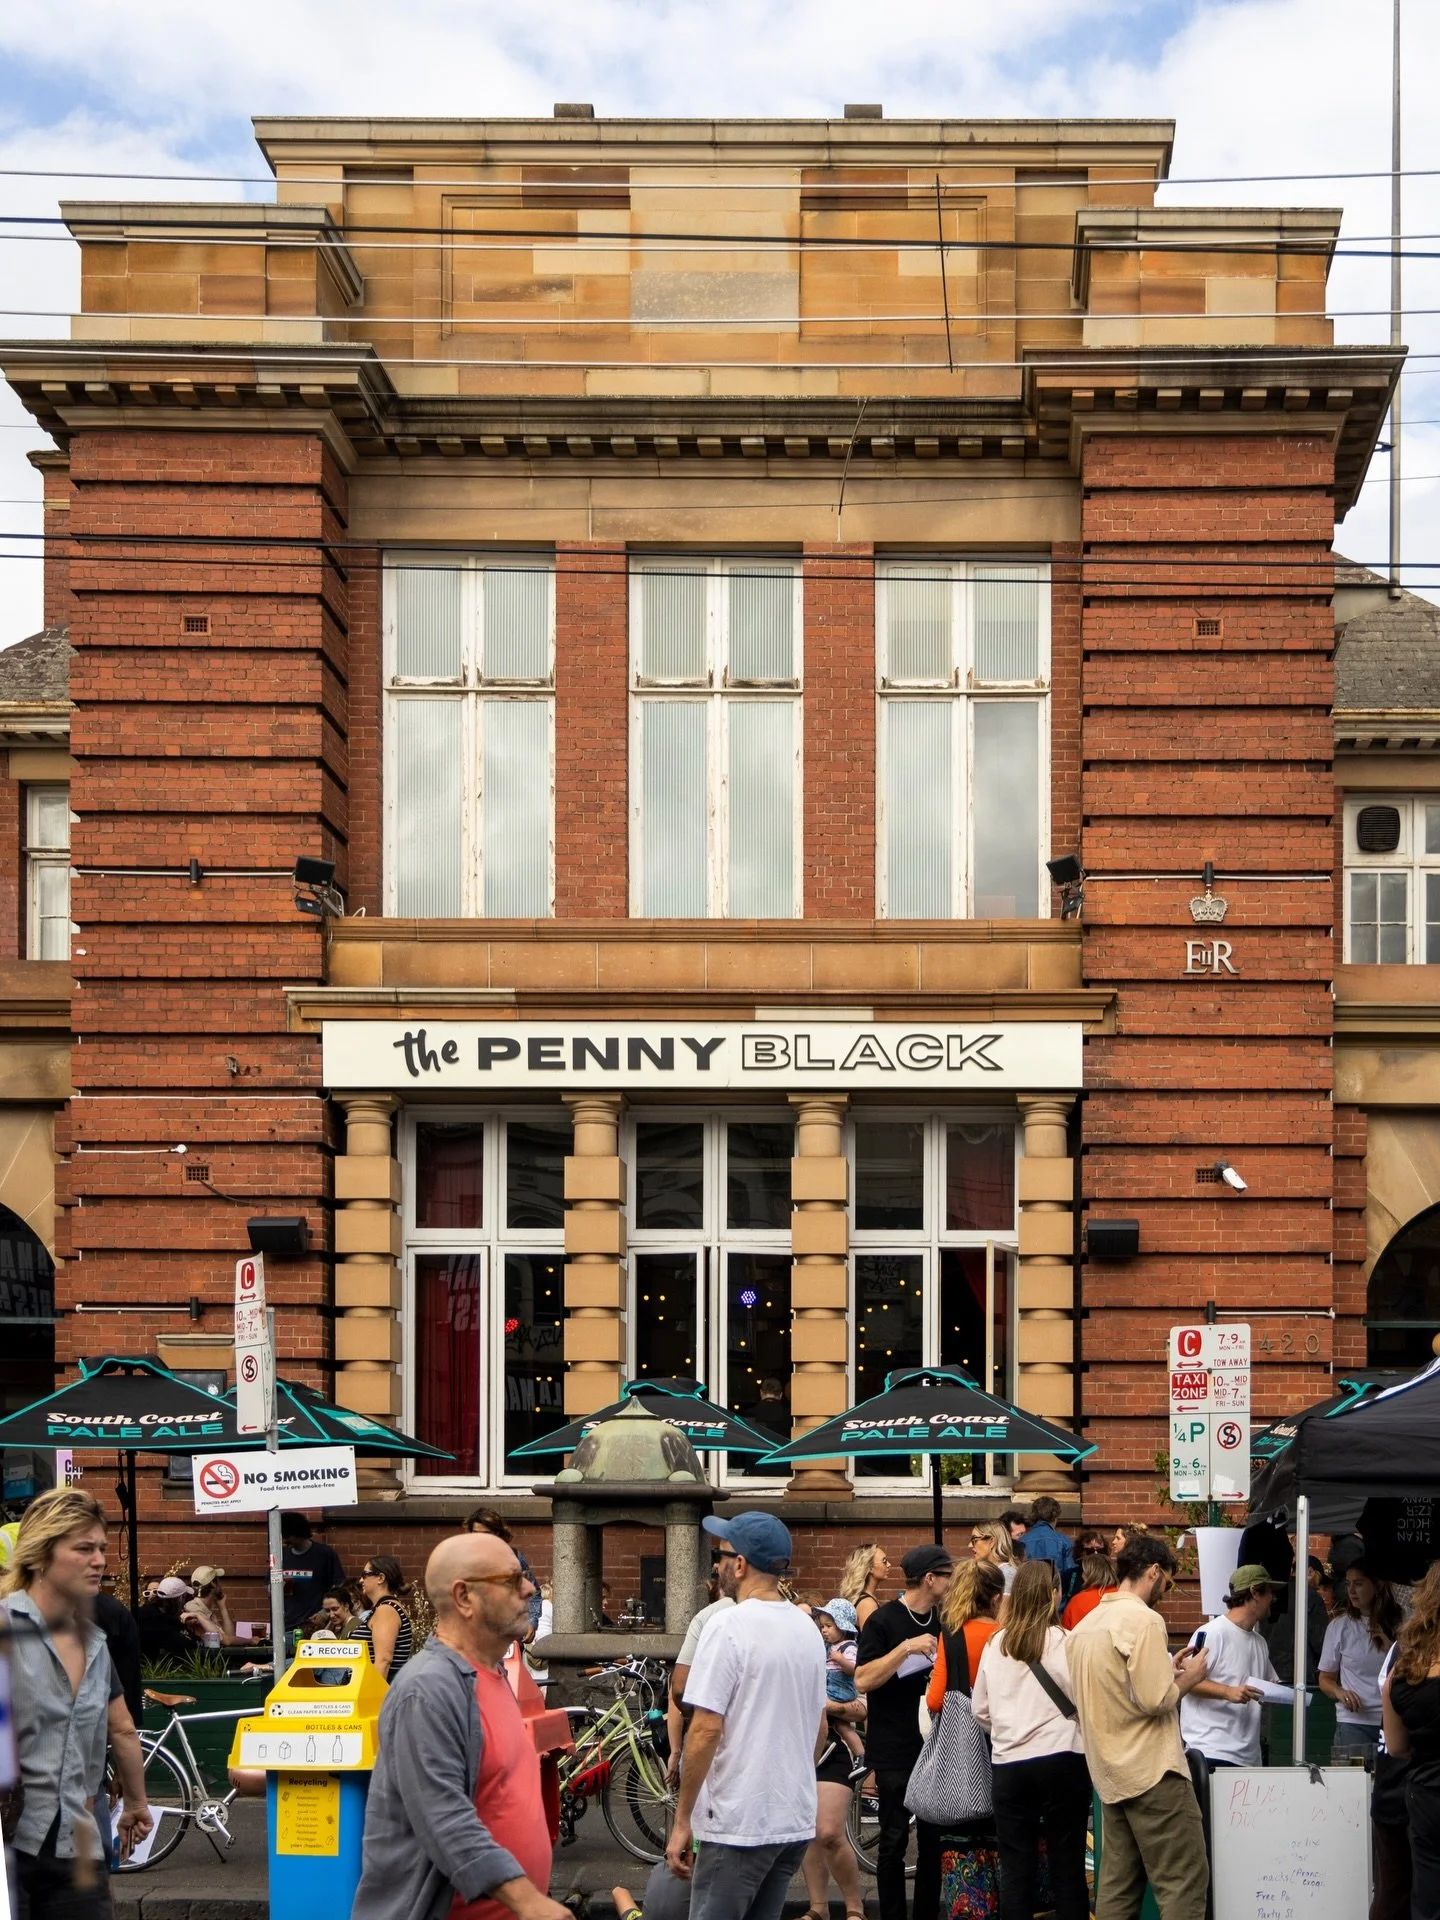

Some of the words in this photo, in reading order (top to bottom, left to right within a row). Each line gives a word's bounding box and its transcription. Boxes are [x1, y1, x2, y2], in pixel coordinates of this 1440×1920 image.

[393, 1029, 459, 1077] the
[478, 1037, 727, 1071] PENNY
[740, 1033, 1004, 1072] BLACK
[1183, 1331, 1196, 1355] C
[1259, 1333, 1320, 1355] 420
[1213, 1359, 1226, 1367] TOW
[1229, 1358, 1248, 1367] AWAY
[1174, 1373, 1205, 1385] TAXI
[1213, 1375, 1224, 1387] 10
[1172, 1387, 1207, 1399] ZONE
[46, 1411, 136, 1426] South
[139, 1411, 224, 1425] Coast
[842, 1415, 926, 1430] South
[929, 1413, 1010, 1425] Coast
[47, 1425, 143, 1438] PALE
[151, 1423, 224, 1437] ALE
[677, 1427, 725, 1438] LE
[840, 1426, 930, 1442] PALE
[937, 1425, 1008, 1438] ALE
[1190, 1422, 1205, 1442] P
[243, 1473, 268, 1485] NO
[273, 1467, 350, 1482] SMOKING
[302, 1482, 335, 1490] smoke-free
[318, 1647, 359, 1655] RECYCLE
[288, 1777, 328, 1787] Recycling
